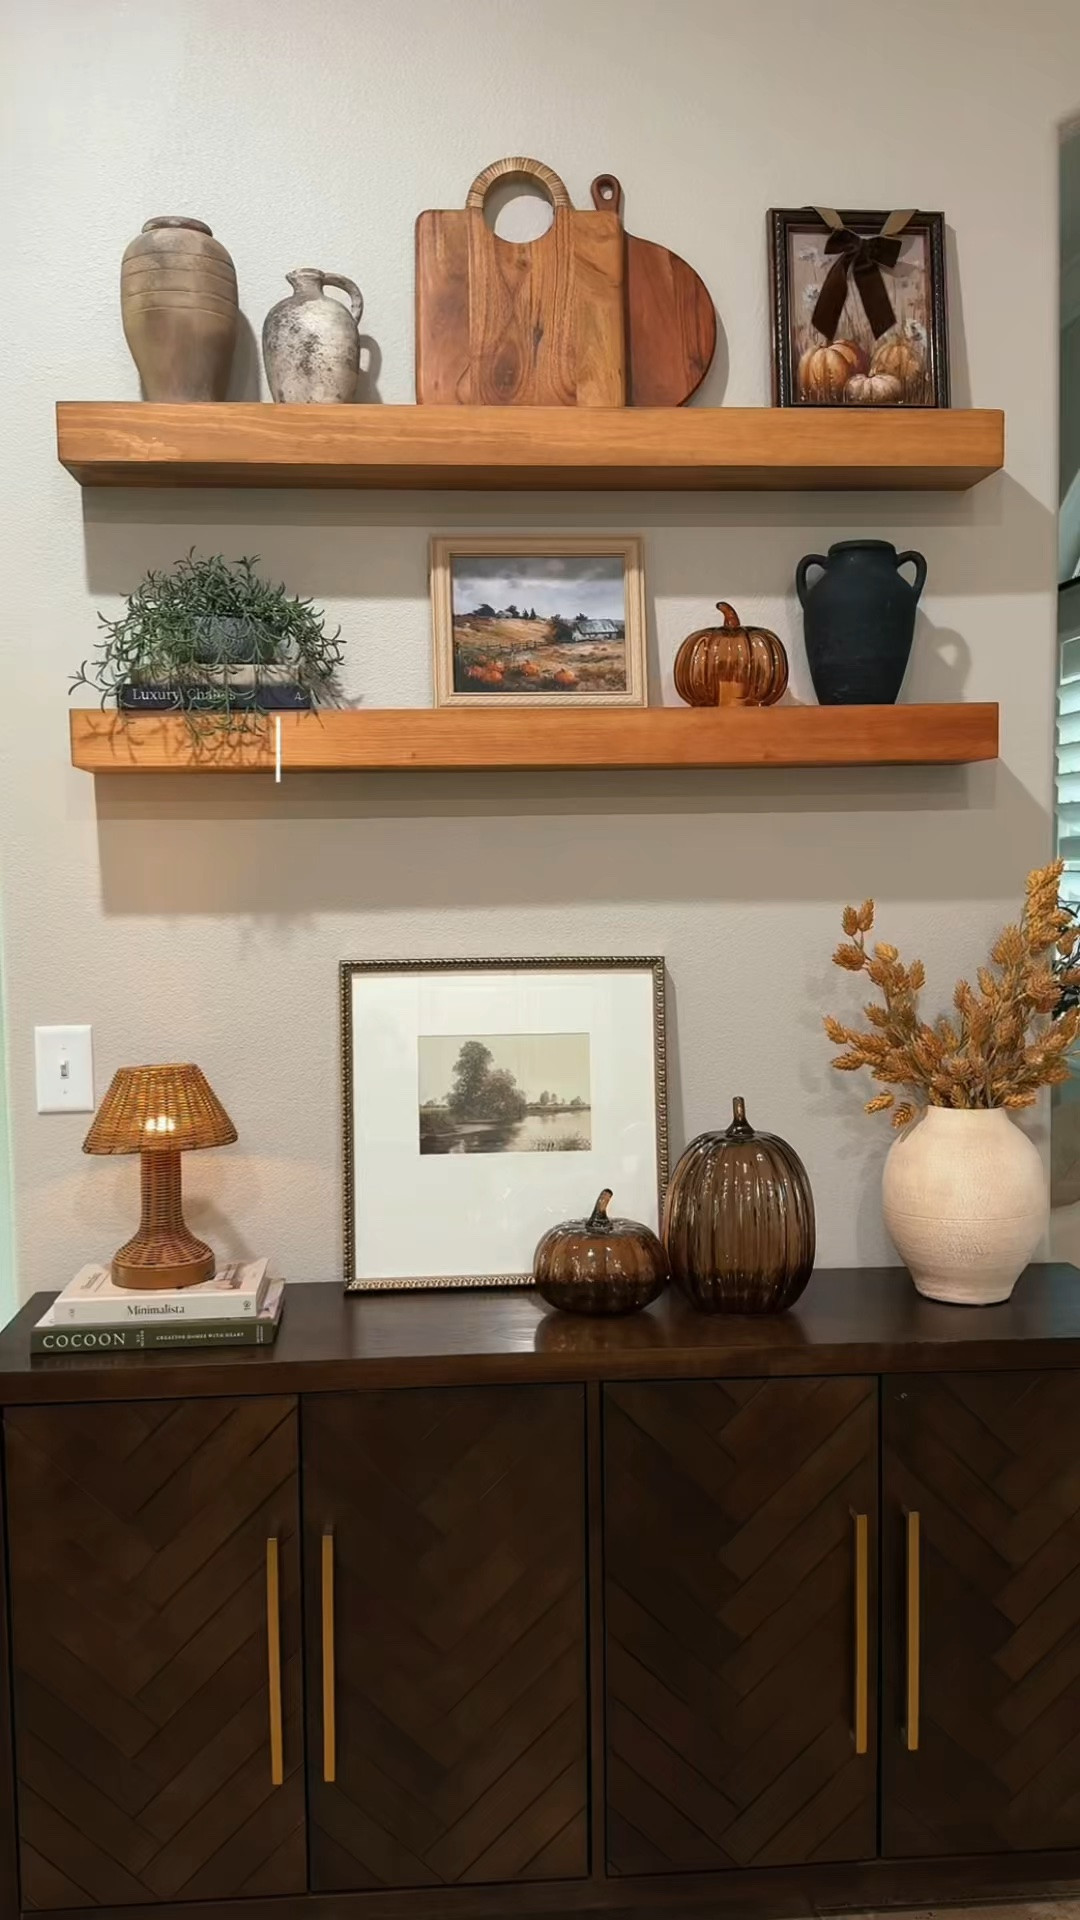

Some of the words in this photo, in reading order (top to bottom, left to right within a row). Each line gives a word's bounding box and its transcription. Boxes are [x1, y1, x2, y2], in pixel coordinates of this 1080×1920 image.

[132, 688, 178, 704] Luxury
[187, 688, 236, 700] Chas
[127, 1304, 185, 1315] Minimalista
[42, 1332, 125, 1348] COCOON
